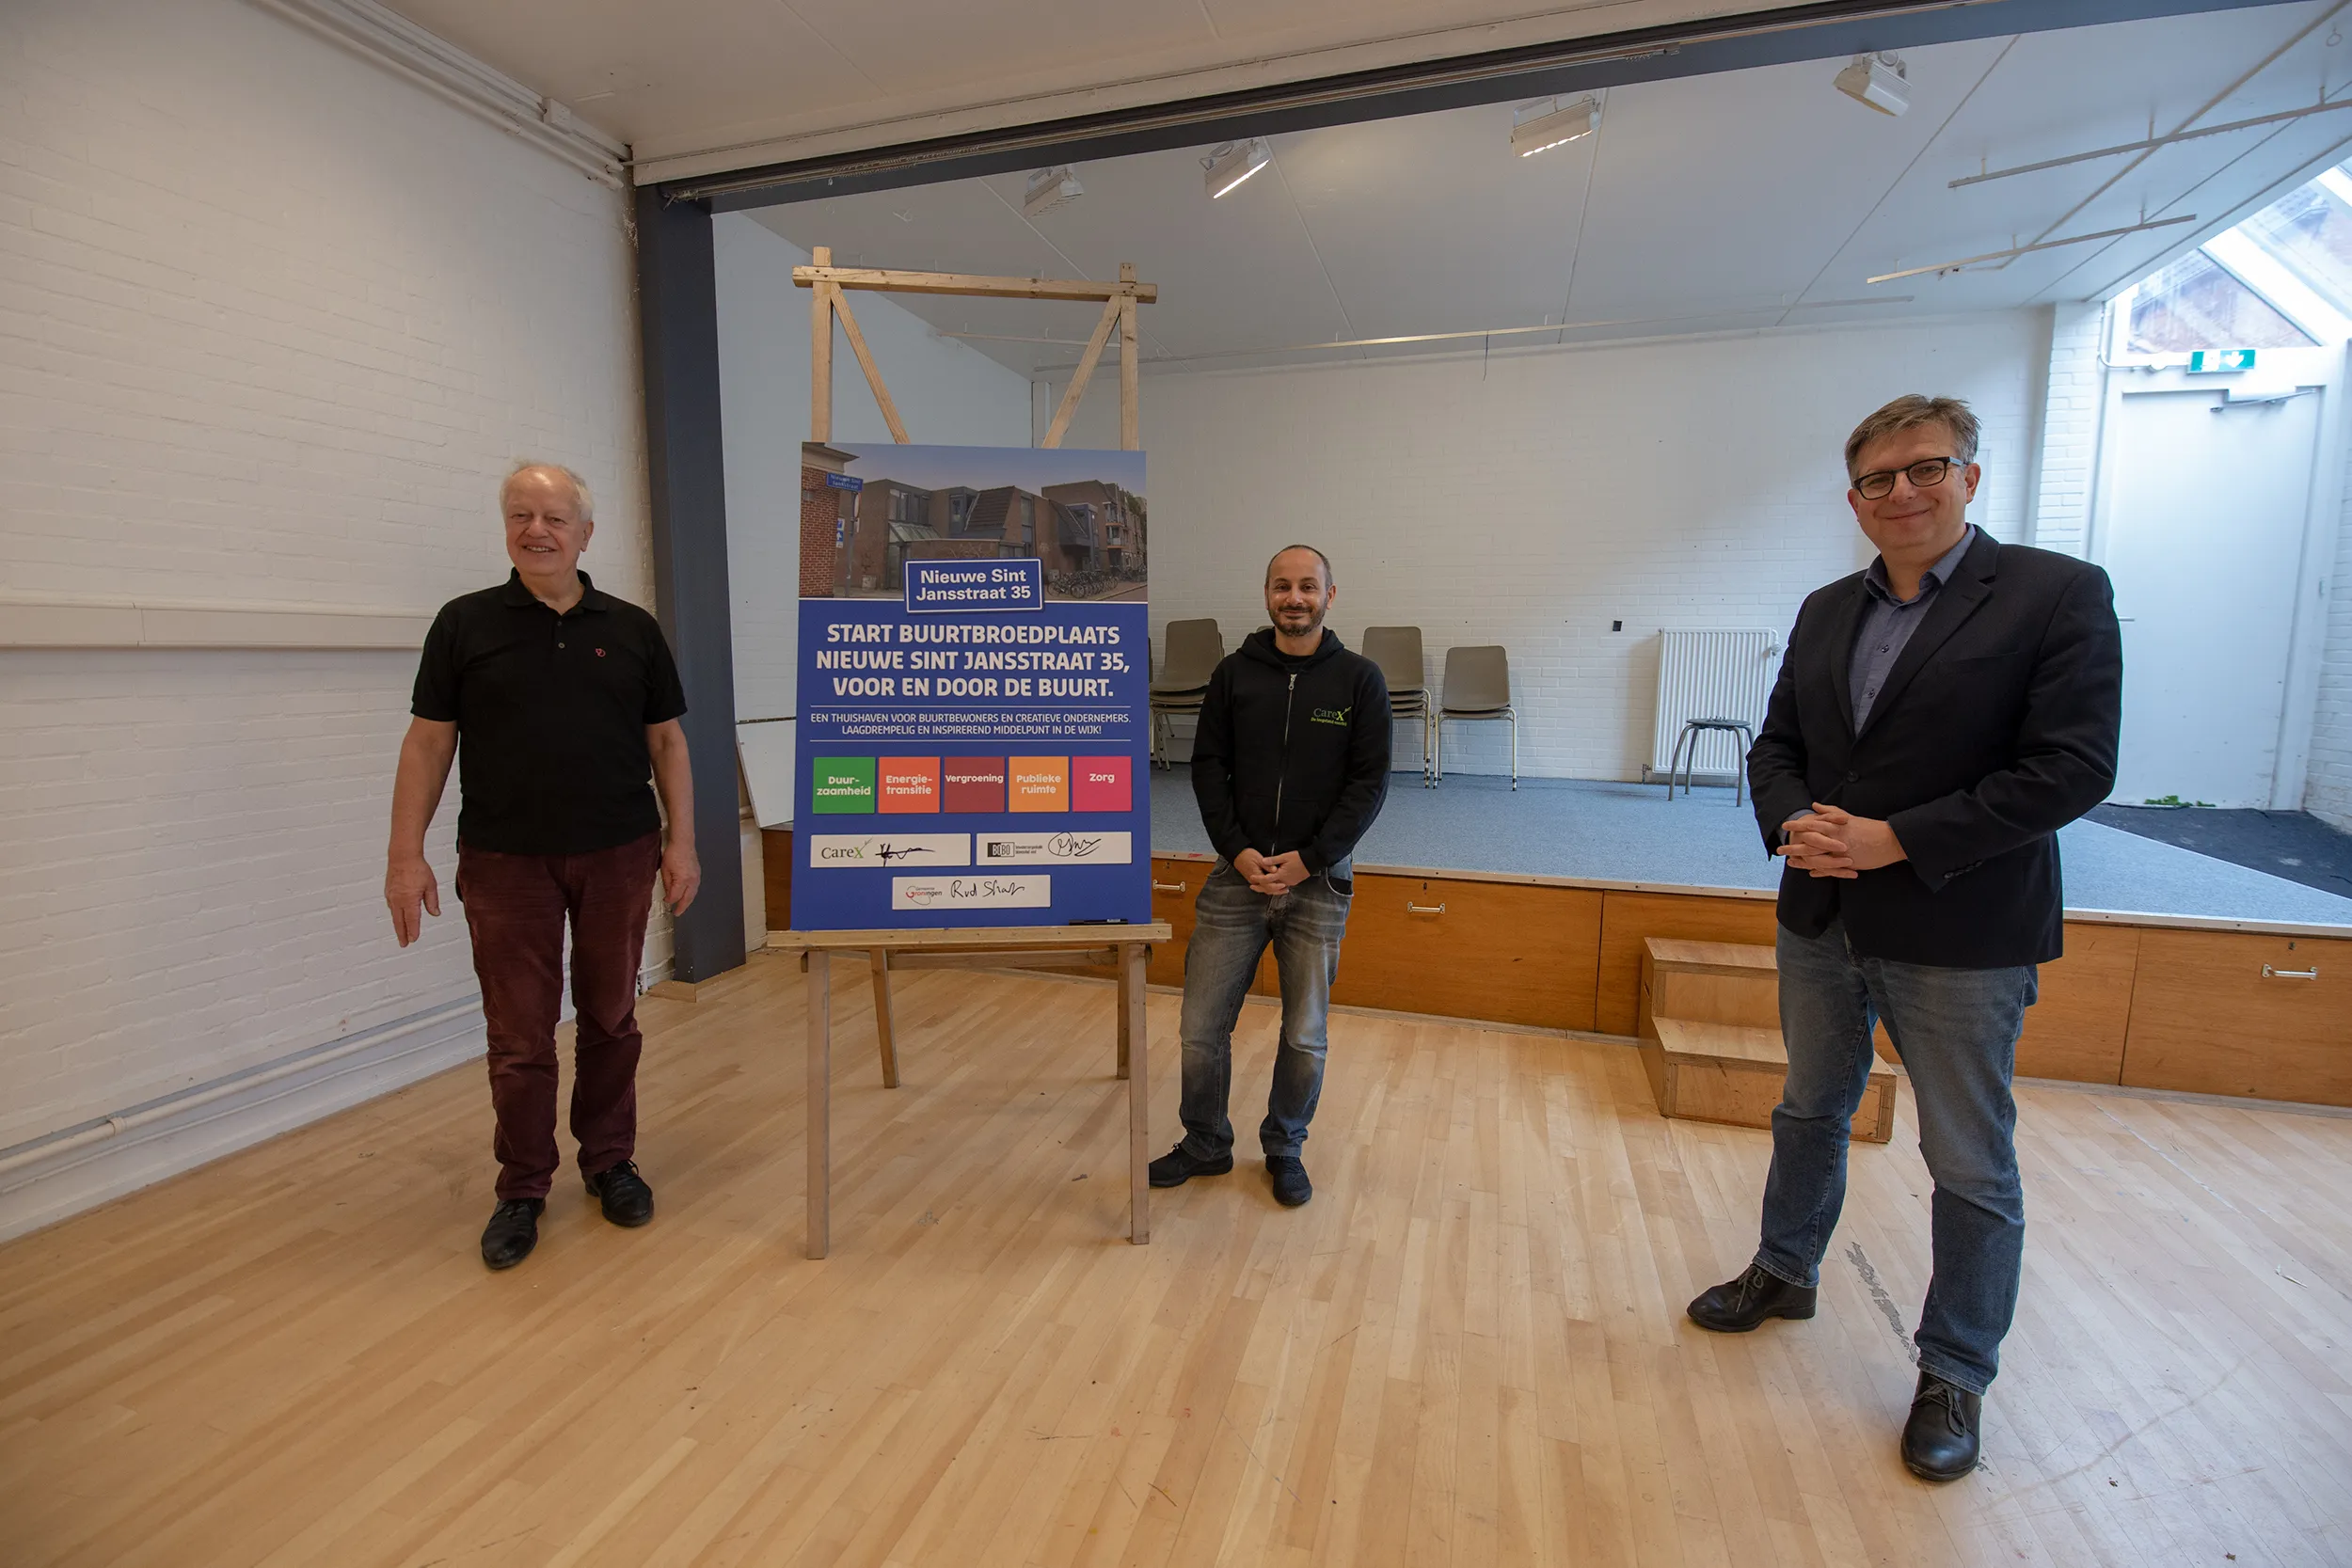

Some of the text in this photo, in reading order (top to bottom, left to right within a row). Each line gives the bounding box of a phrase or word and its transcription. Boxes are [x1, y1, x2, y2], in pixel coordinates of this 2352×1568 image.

[920, 568, 1026, 583] Nieuwe Sint
[915, 585, 1031, 601] Jansstraat 35
[827, 624, 1120, 644] START BUURTBROEDPLAATS
[817, 650, 1130, 673] NIEUWE SINT JANSSTRAAT 35,
[833, 677, 1114, 697] VOOR EN DOOR DE BUURT.
[810, 713, 1131, 723] EEN THUISHAVEN VOOR BUURTBEWONERS EN CREATIEVE ONDERNEMERS.
[842, 725, 1102, 735] LAAGDREMPELIG EN INSPIREREND MIDDELPUNT IN DE WIJK!
[828, 776, 860, 784] Duur-
[885, 774, 933, 785] Energie-
[945, 773, 1004, 784] Vergroening
[1016, 773, 1061, 784] Publieke
[1089, 773, 1115, 784] Zorg
[817, 785, 871, 796] zaamheid
[885, 785, 932, 795] transitie
[1021, 784, 1057, 794] ruimte
[905, 890, 943, 898] Groningen
